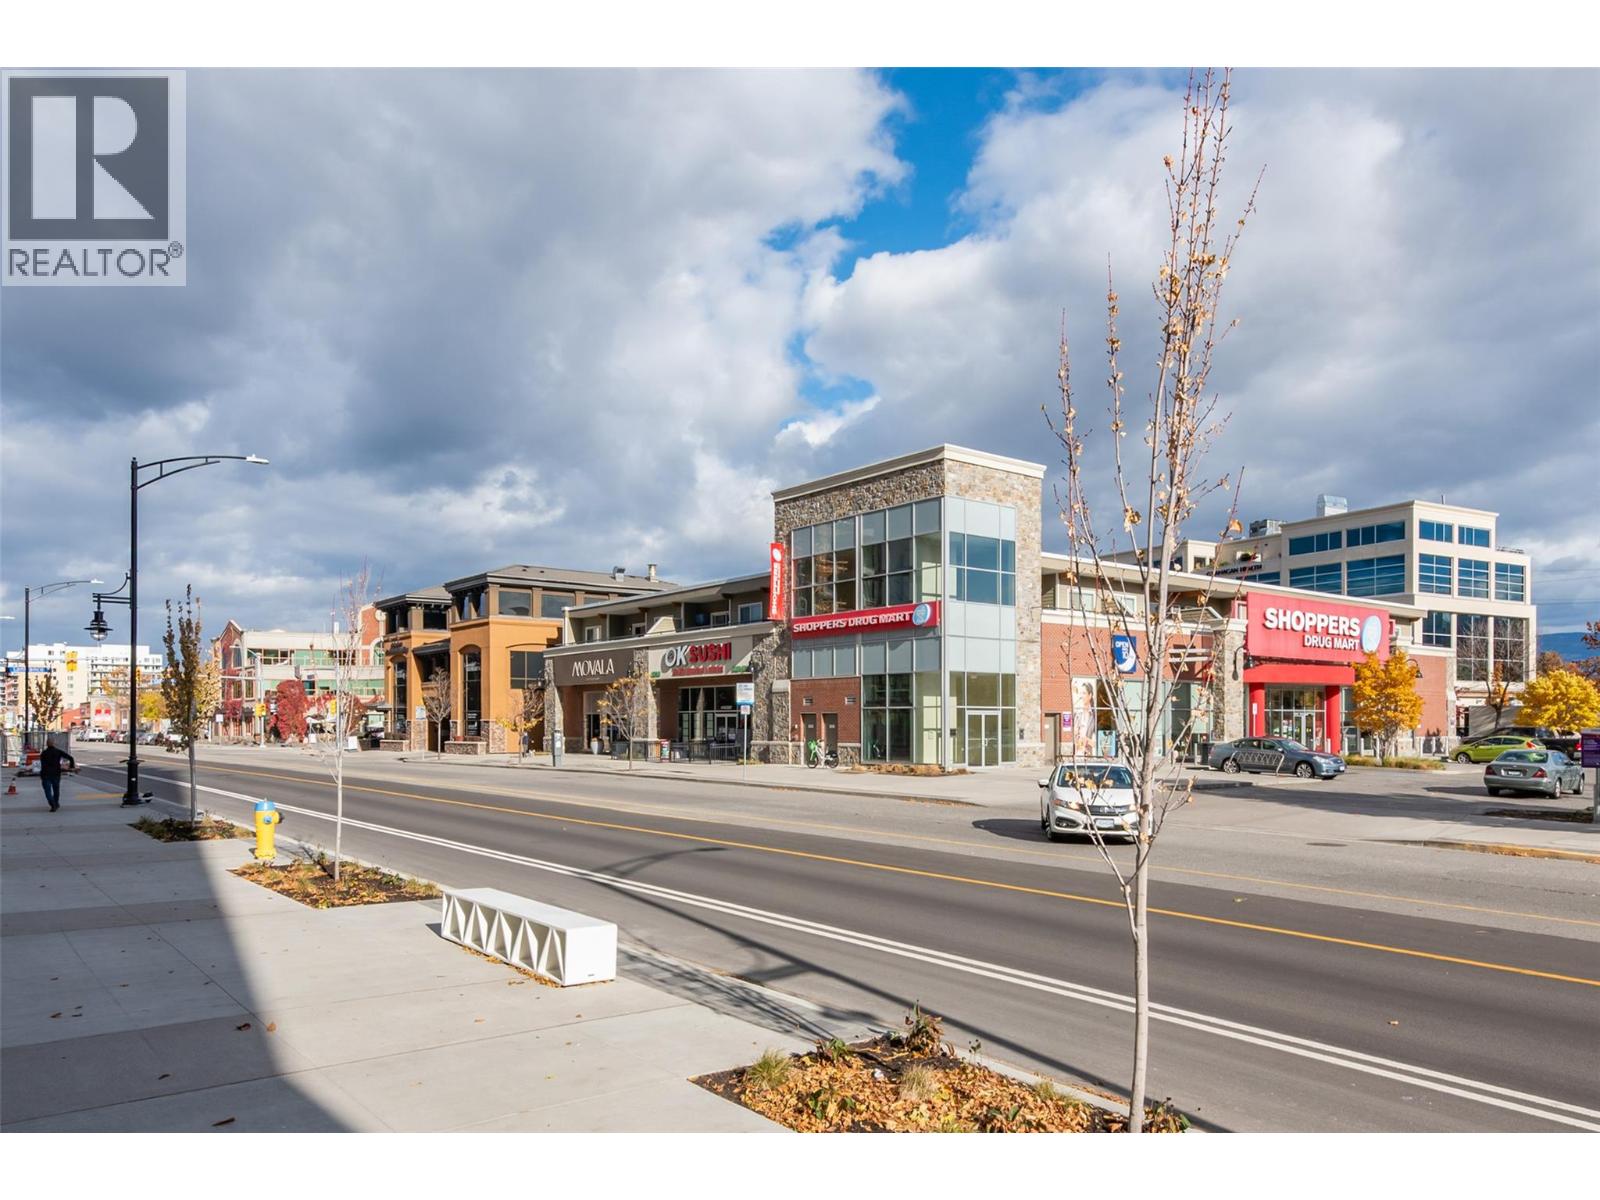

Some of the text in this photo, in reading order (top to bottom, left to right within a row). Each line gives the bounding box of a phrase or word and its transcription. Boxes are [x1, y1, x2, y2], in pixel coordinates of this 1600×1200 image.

[793, 611, 913, 633] SHOPPERS DRUG MART
[1264, 607, 1361, 637] SHOPPERS
[1304, 634, 1360, 650] DRUG MART
[664, 643, 732, 667] OK SUSHI
[571, 658, 615, 677] MOVALA
